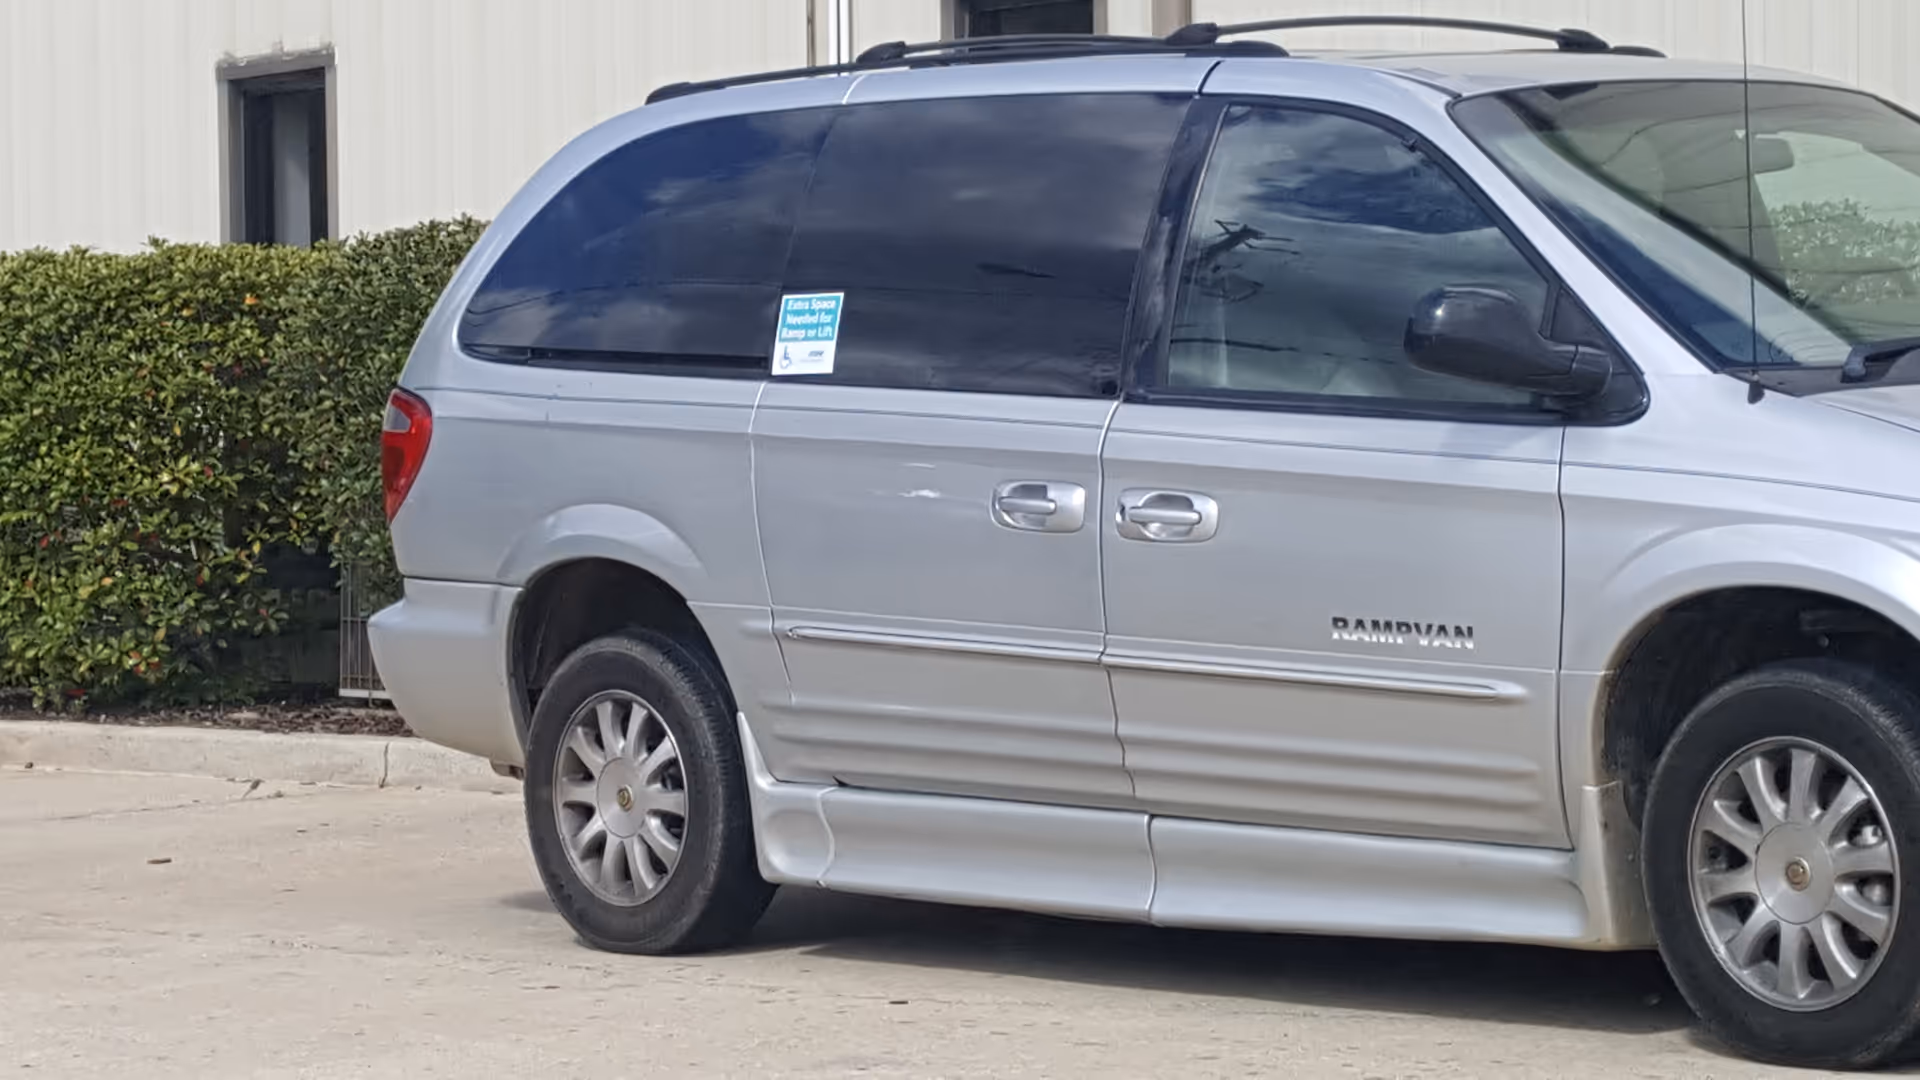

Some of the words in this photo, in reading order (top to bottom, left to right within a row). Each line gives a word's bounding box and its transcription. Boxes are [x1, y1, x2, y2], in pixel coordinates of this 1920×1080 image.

[787, 300, 809, 310] Extra
[811, 299, 836, 311] Space
[786, 312, 819, 325] Needed
[820, 311, 834, 323] for
[781, 328, 806, 340] Ramp
[807, 329, 817, 338] or
[818, 326, 833, 338] Lift
[1332, 616, 1475, 649] RAMPVAN
